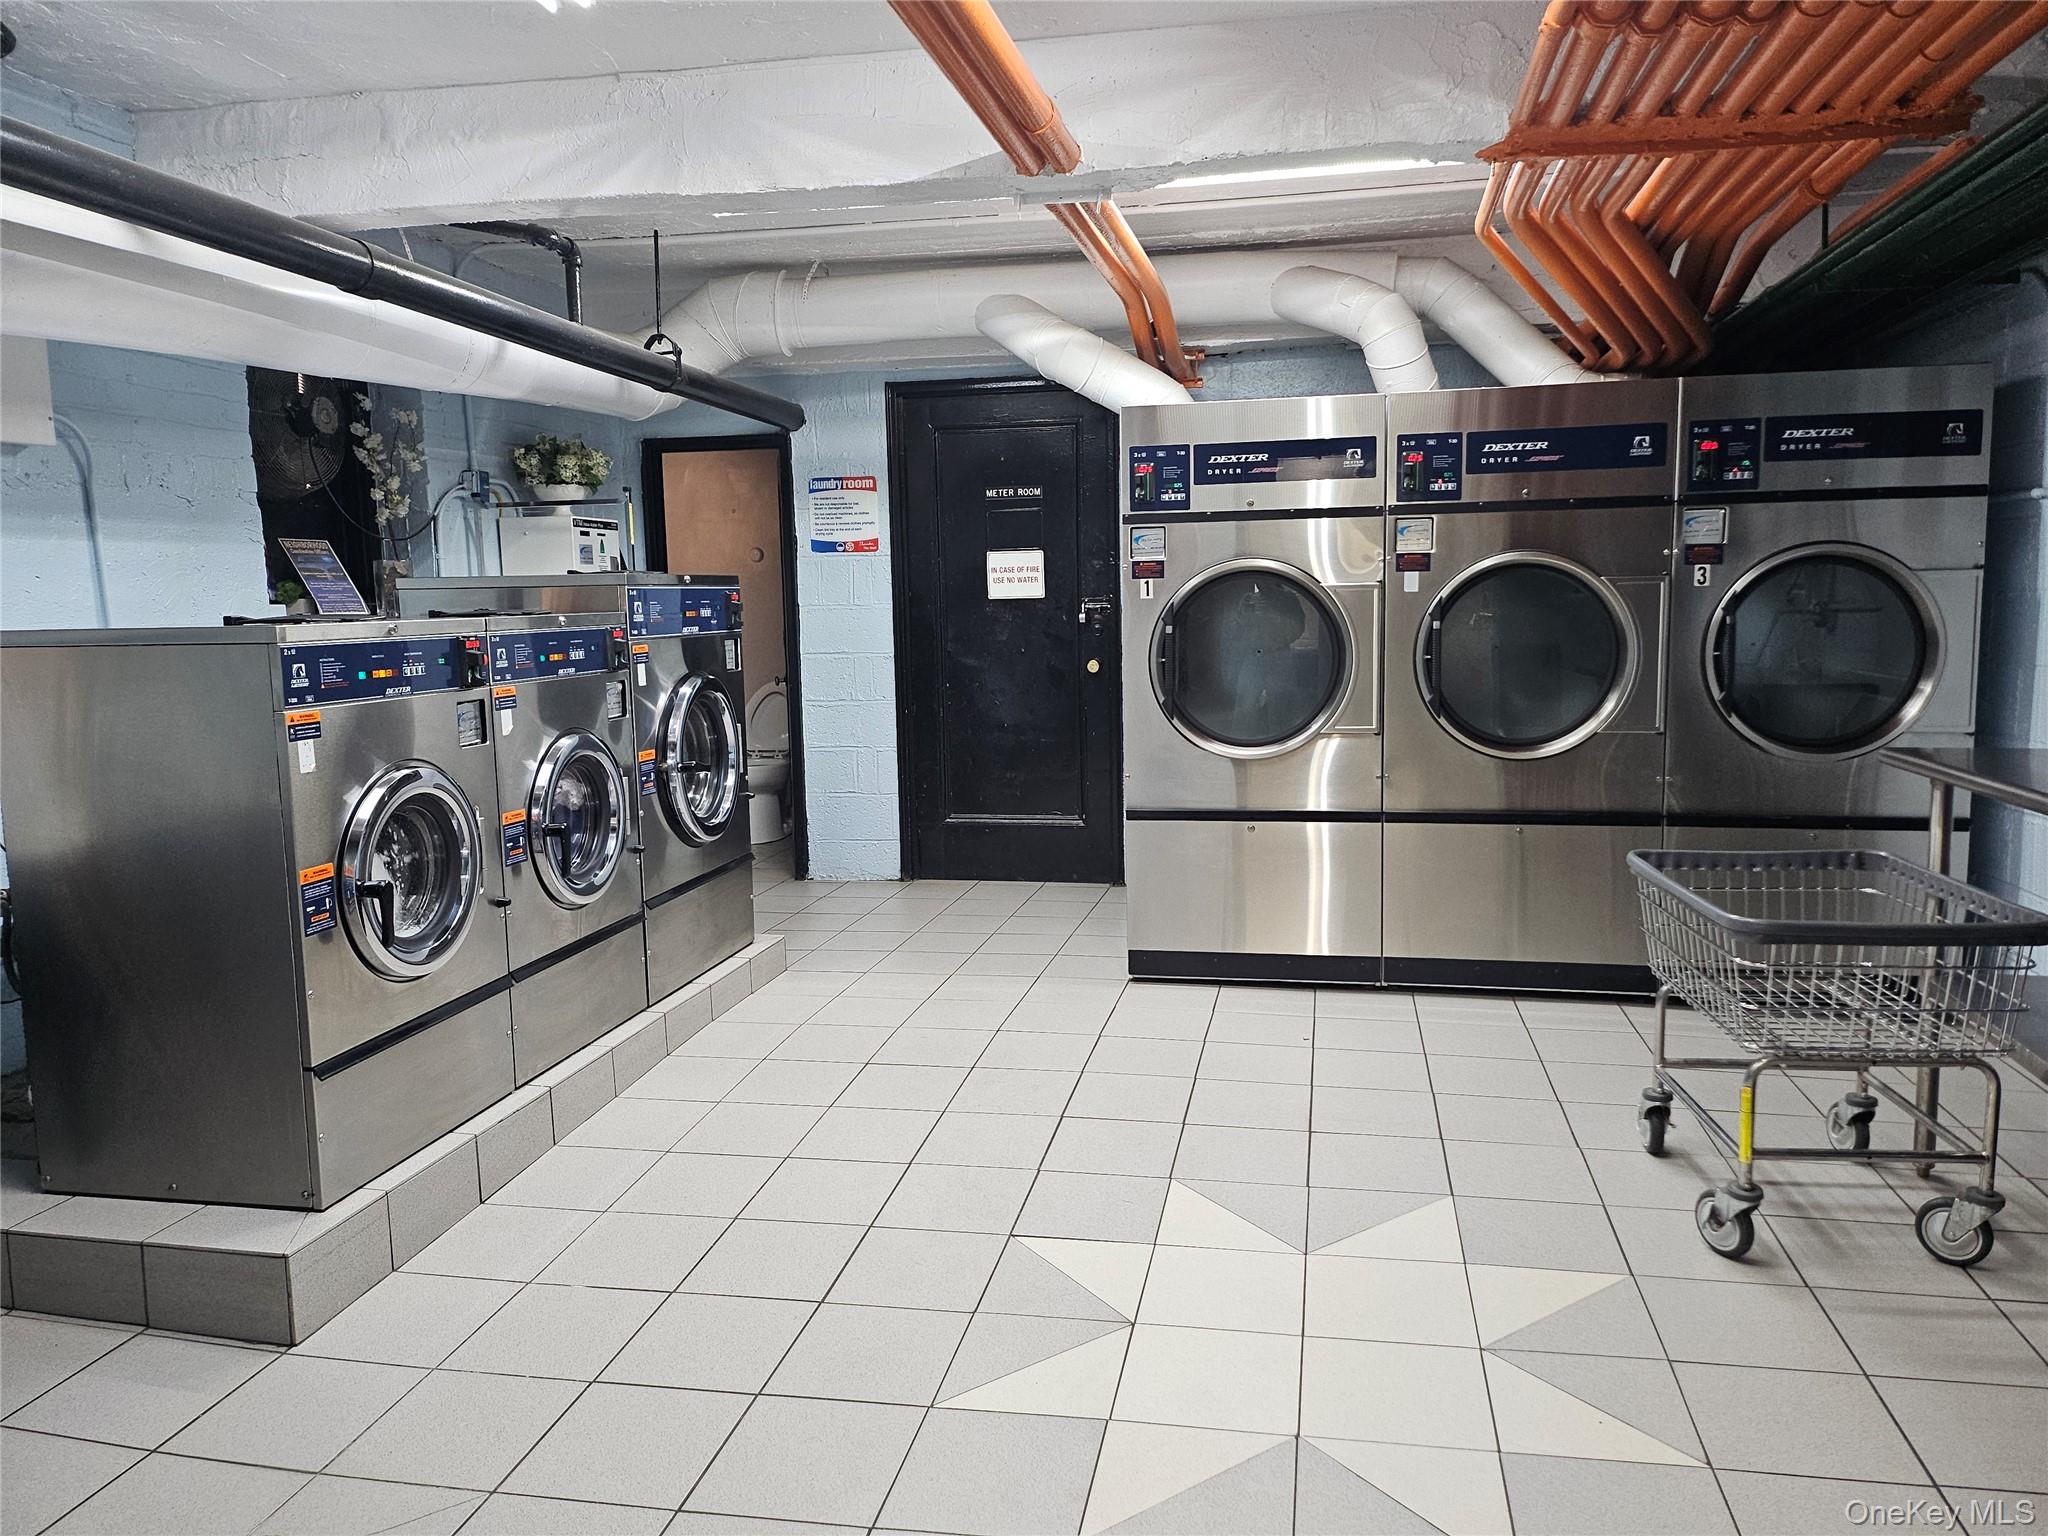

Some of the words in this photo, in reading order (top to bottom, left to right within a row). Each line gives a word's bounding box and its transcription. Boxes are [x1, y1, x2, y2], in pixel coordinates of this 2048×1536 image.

[1782, 428, 1854, 438] DEXTER
[1482, 441, 1548, 452] DEXTER
[1208, 453, 1269, 464] DEXTER
[986, 489, 1014, 497] METER
[1697, 566, 1706, 585] 3
[1144, 580, 1149, 596] 1
